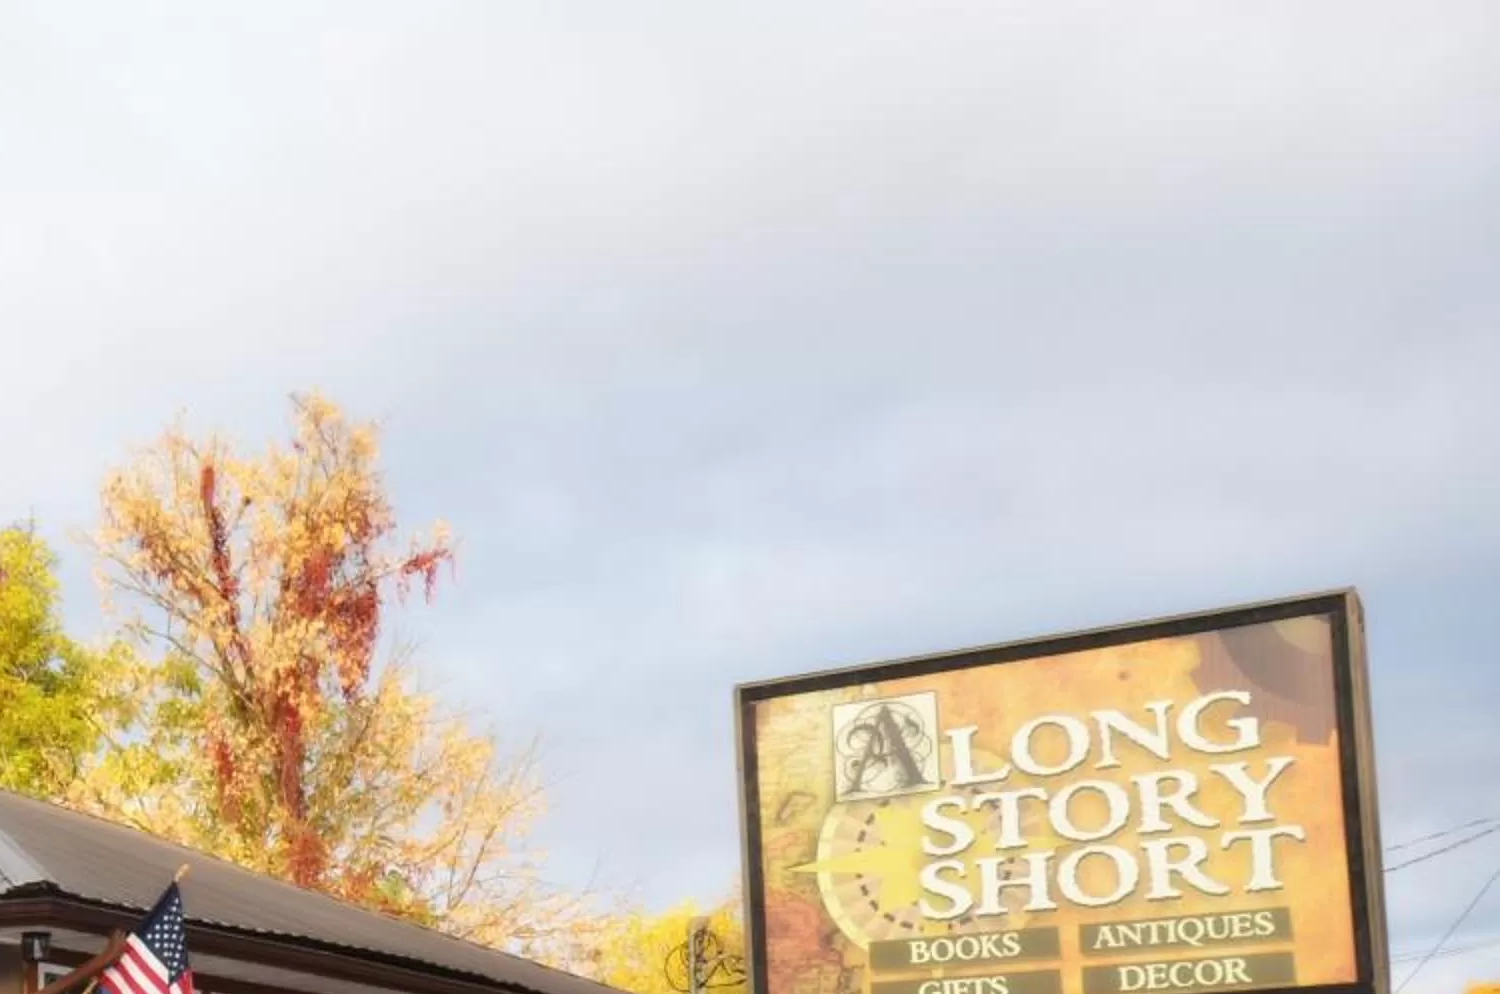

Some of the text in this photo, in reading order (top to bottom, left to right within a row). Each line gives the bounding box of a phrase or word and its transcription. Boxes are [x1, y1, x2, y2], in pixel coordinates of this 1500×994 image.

[838, 690, 1261, 796] A LONG
[921, 757, 1295, 857] STORY
[918, 825, 1306, 920] SHORT
[909, 934, 1021, 964] BOOKS
[1093, 911, 1276, 950] ANTIQUES
[1119, 958, 1253, 992] DECOR
